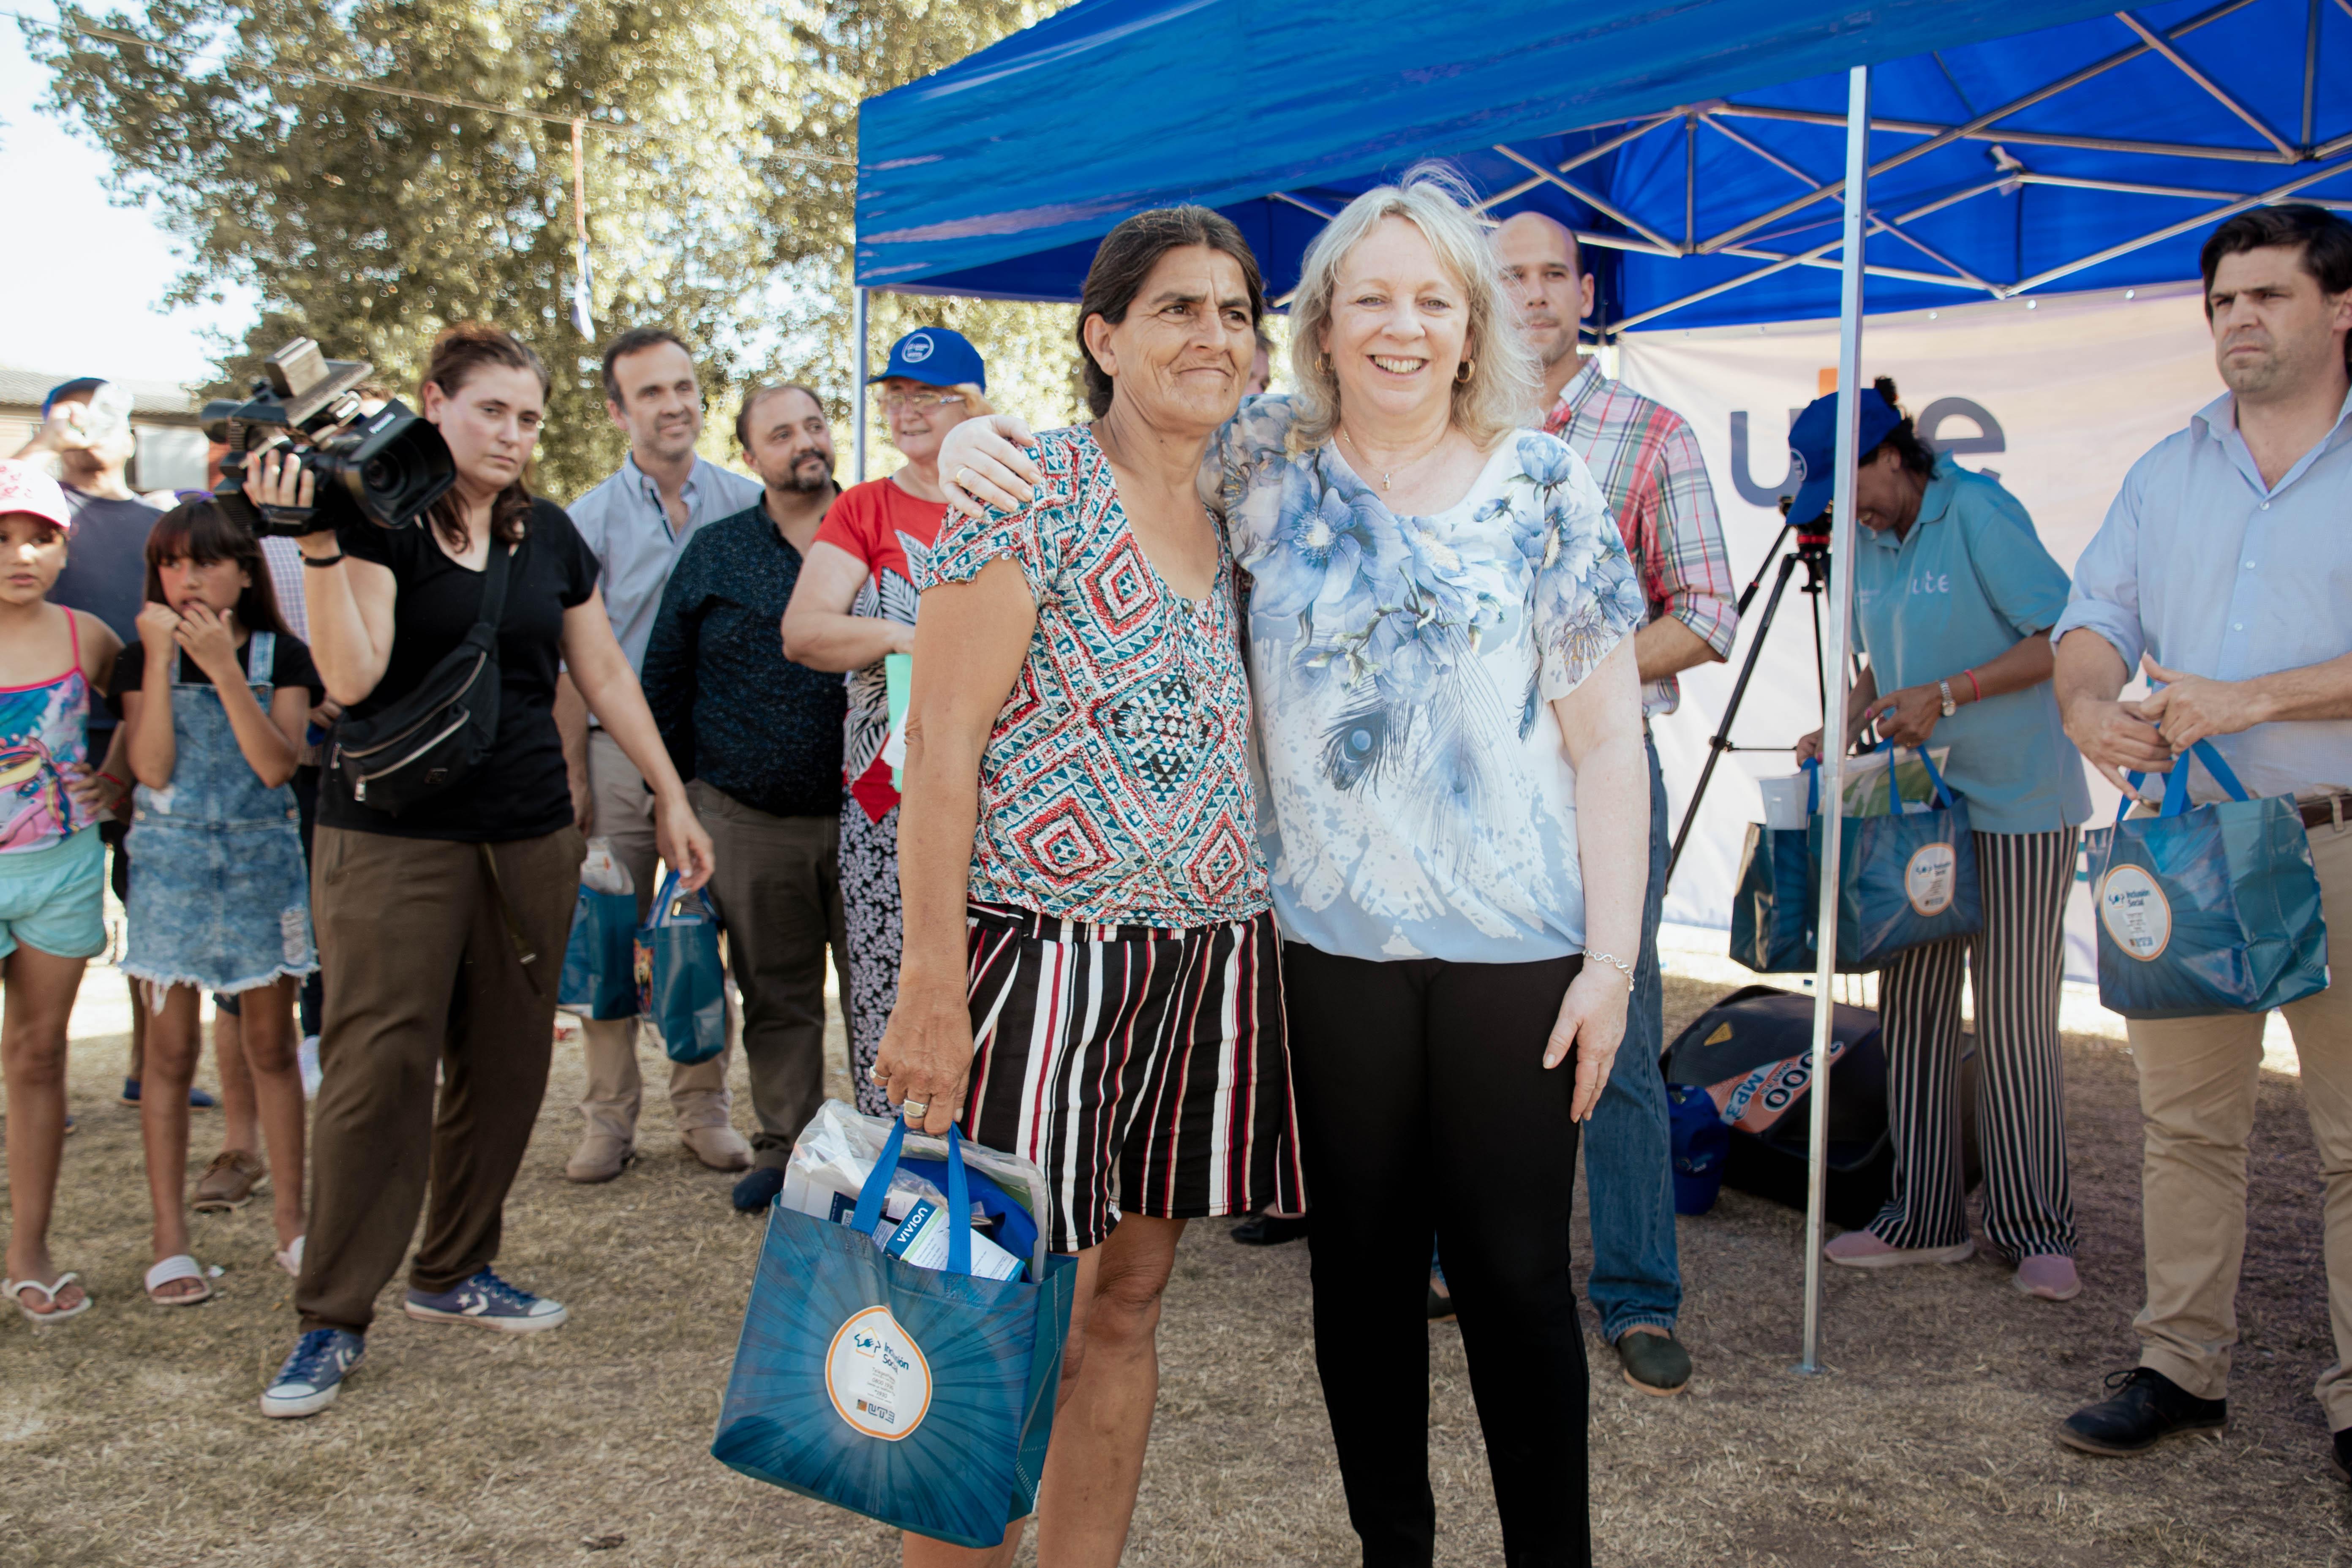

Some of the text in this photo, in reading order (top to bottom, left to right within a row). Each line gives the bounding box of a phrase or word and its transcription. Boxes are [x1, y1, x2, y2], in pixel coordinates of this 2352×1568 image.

[1730, 368, 2006, 507] ue
[1726, 1073, 1765, 1118] MP3
[882, 1353, 898, 1375] Social
[884, 1342, 909, 1370] Inclusión
